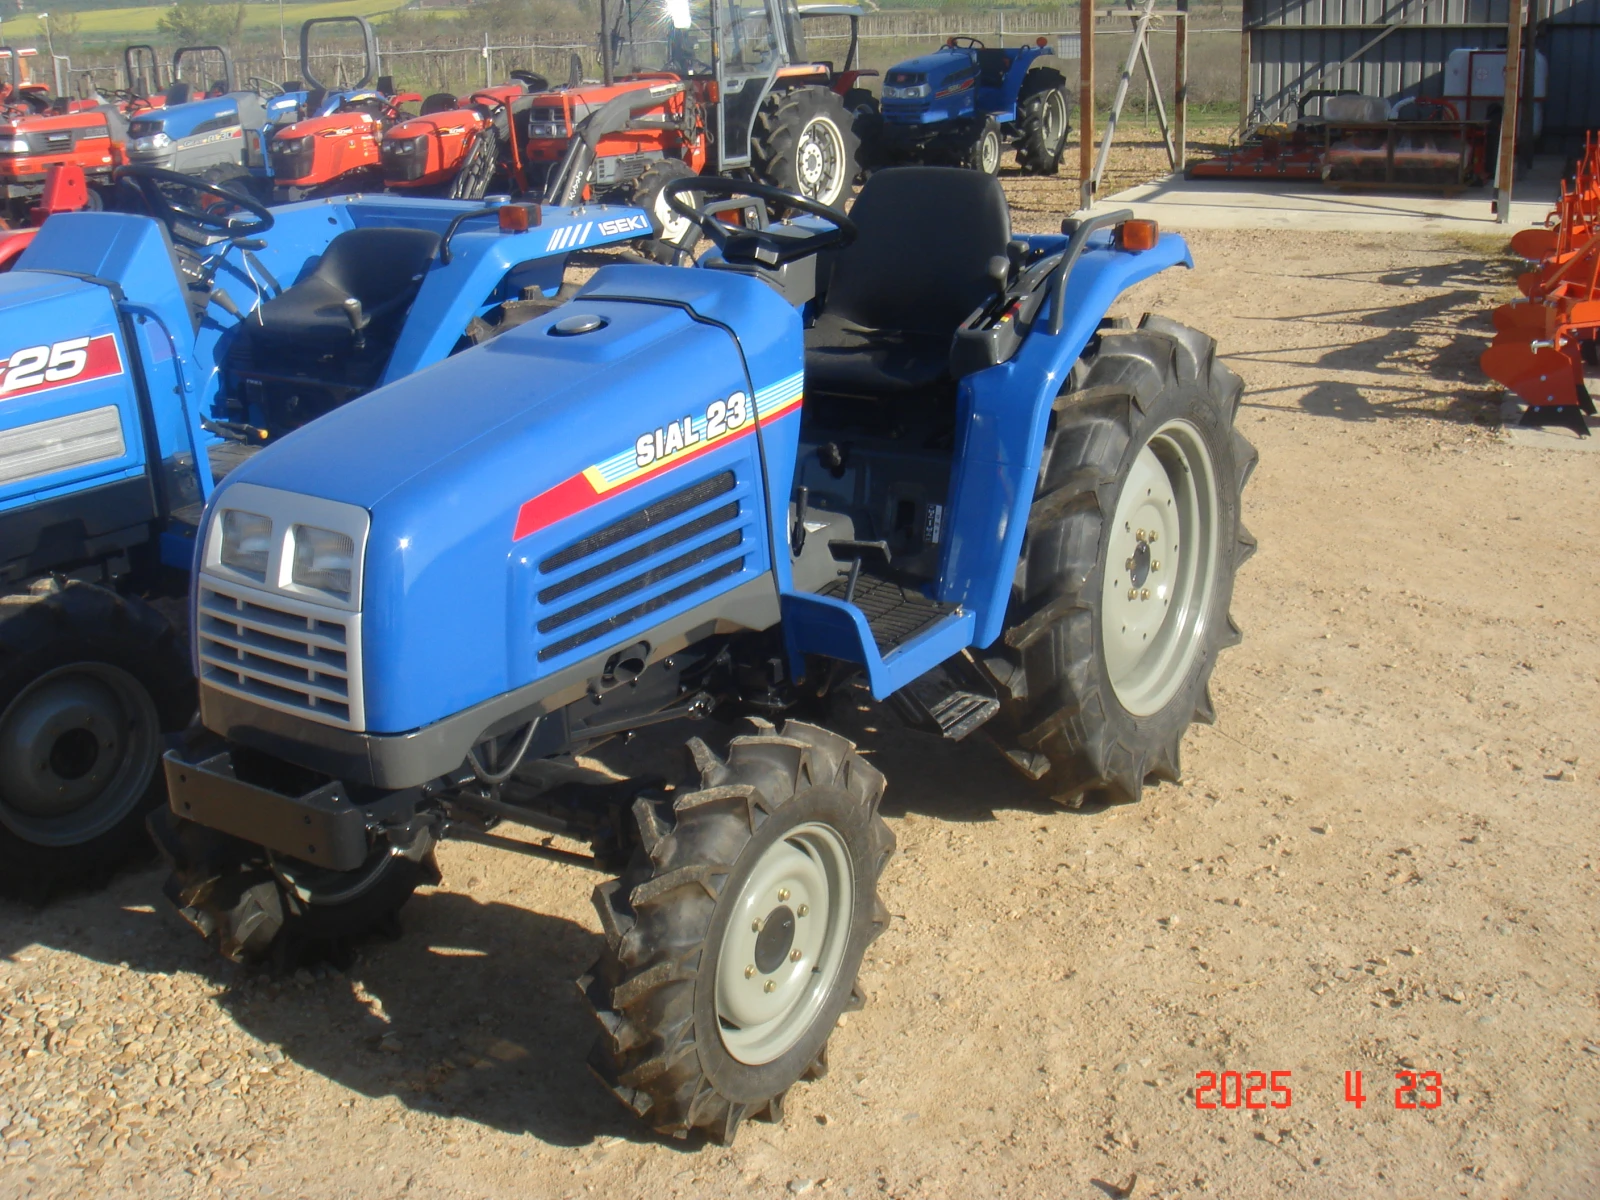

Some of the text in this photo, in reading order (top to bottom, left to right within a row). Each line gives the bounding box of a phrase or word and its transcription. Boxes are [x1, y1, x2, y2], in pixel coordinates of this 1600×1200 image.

[568, 170, 584, 201] Kubota
[597, 214, 648, 236] ISEKI
[0, 335, 91, 395] 25
[635, 390, 747, 468] SIAL 23
